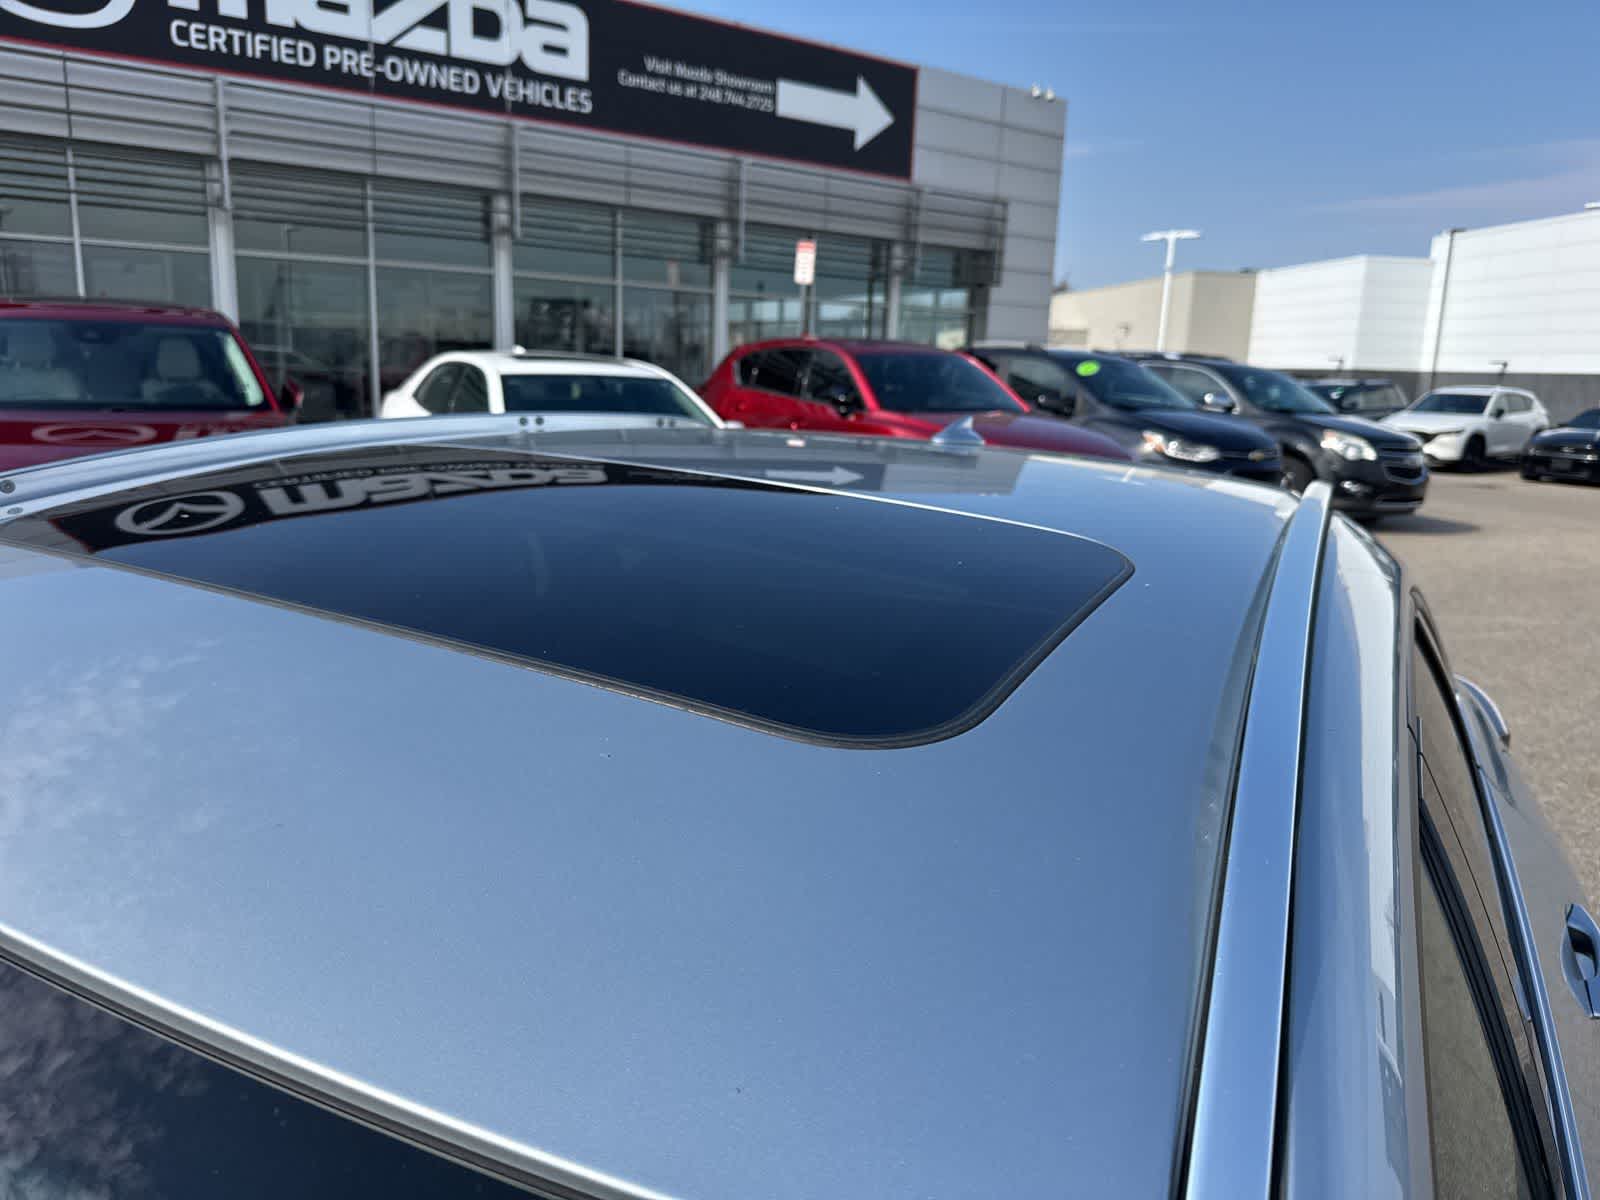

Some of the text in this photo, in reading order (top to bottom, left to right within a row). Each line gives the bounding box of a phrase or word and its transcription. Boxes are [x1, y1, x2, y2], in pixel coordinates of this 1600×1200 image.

[169, 19, 593, 114] CERTIFIED PRE-OWNED VEHICLES
[617, 69, 666, 93] Contact
[667, 81, 683, 97] us
[684, 84, 697, 99] at
[643, 55, 775, 95] Visit Mazda Showroom
